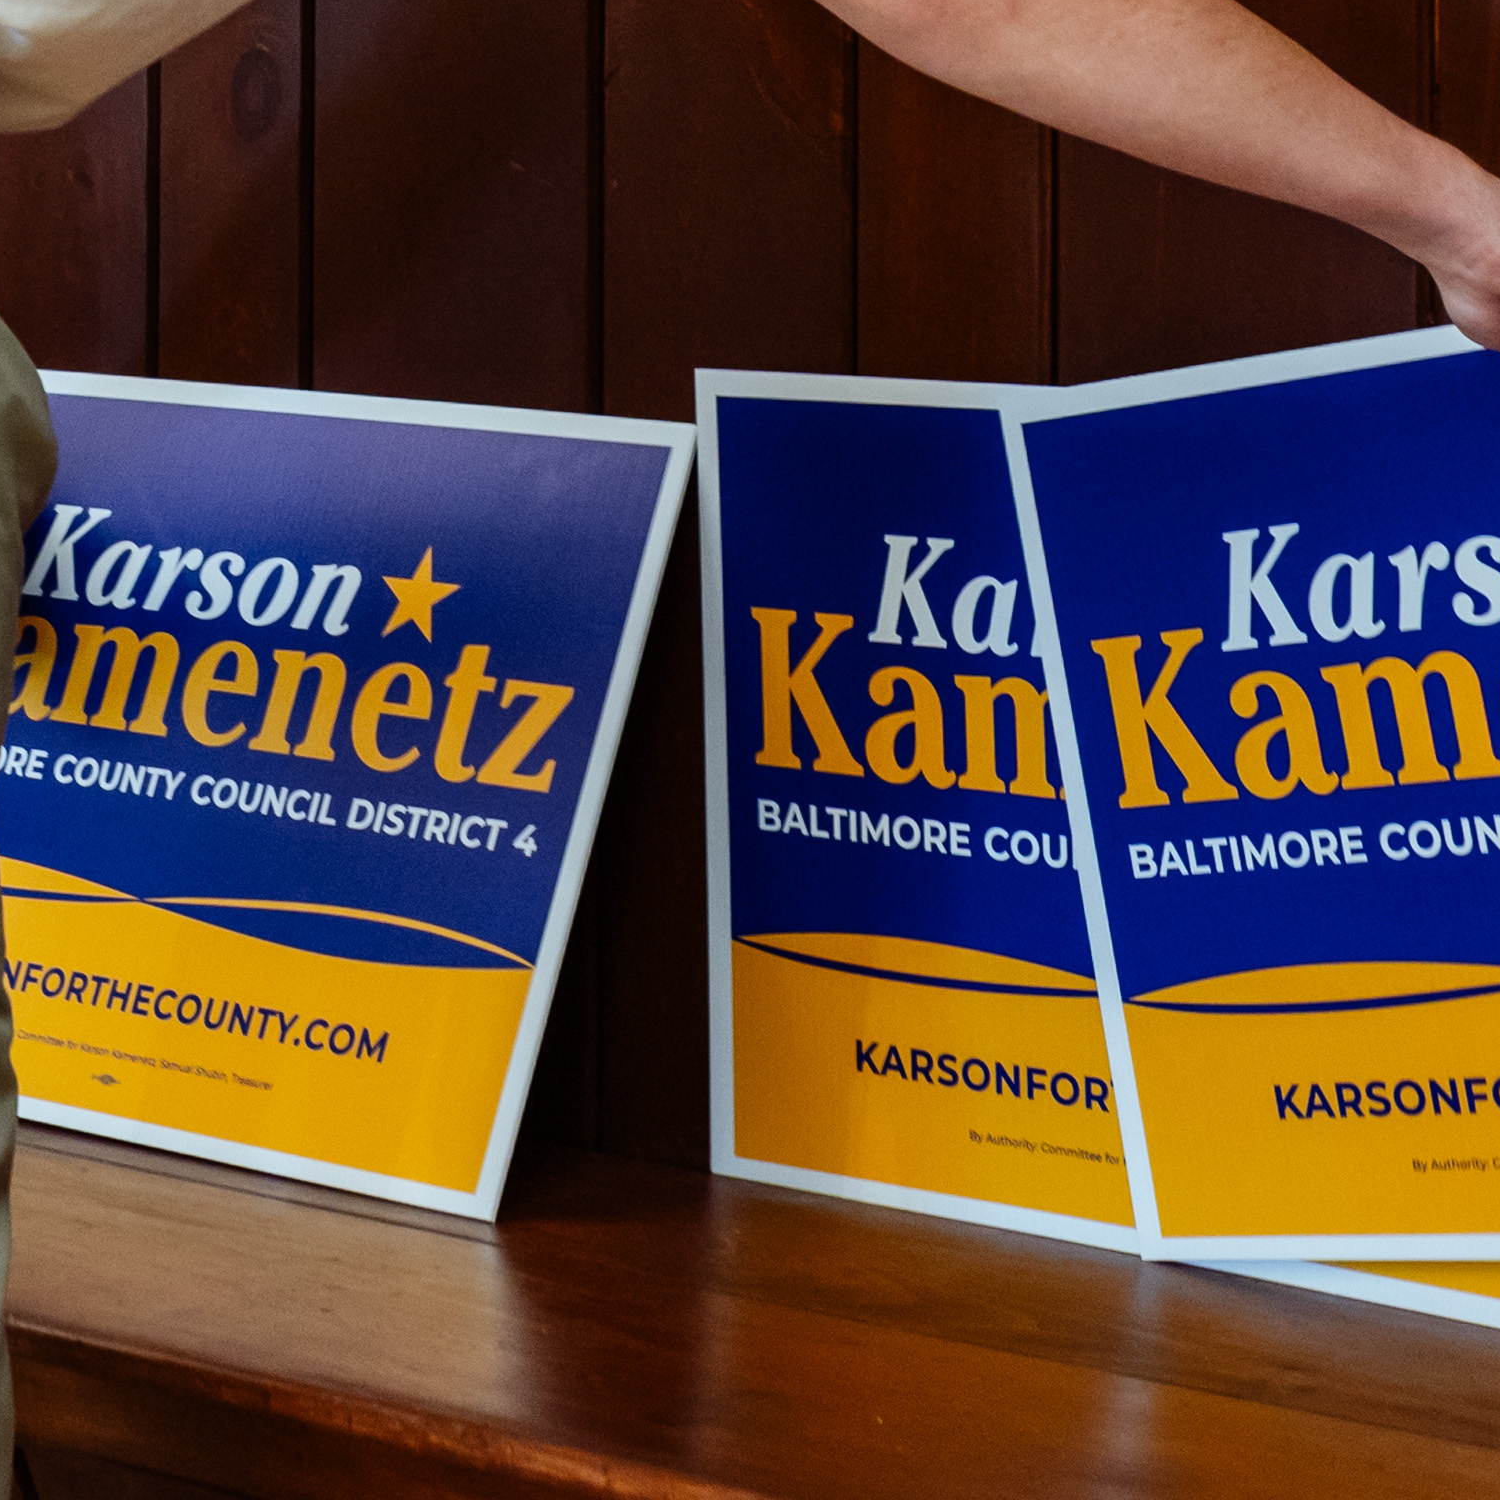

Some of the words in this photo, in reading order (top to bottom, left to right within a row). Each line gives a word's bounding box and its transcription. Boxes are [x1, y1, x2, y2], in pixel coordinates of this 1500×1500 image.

[21, 503, 362, 636] Karson
[868, 534, 1040, 658] Ka
[8, 615, 575, 793] amenetz
[751, 606, 1067, 801] Kam
[53, 753, 187, 801] COUNTY
[190, 774, 337, 826] COUNCIL
[346, 797, 509, 852] DISTRICT
[512, 824, 538, 858] 4
[757, 798, 972, 858] BALTIMORE
[984, 826, 1078, 871] COU
[1128, 826, 1368, 879] BALTIMORE
[3, 959, 389, 1063] NFORTHECOUNTY.COM
[855, 1038, 1114, 1113] KARSONFOR
